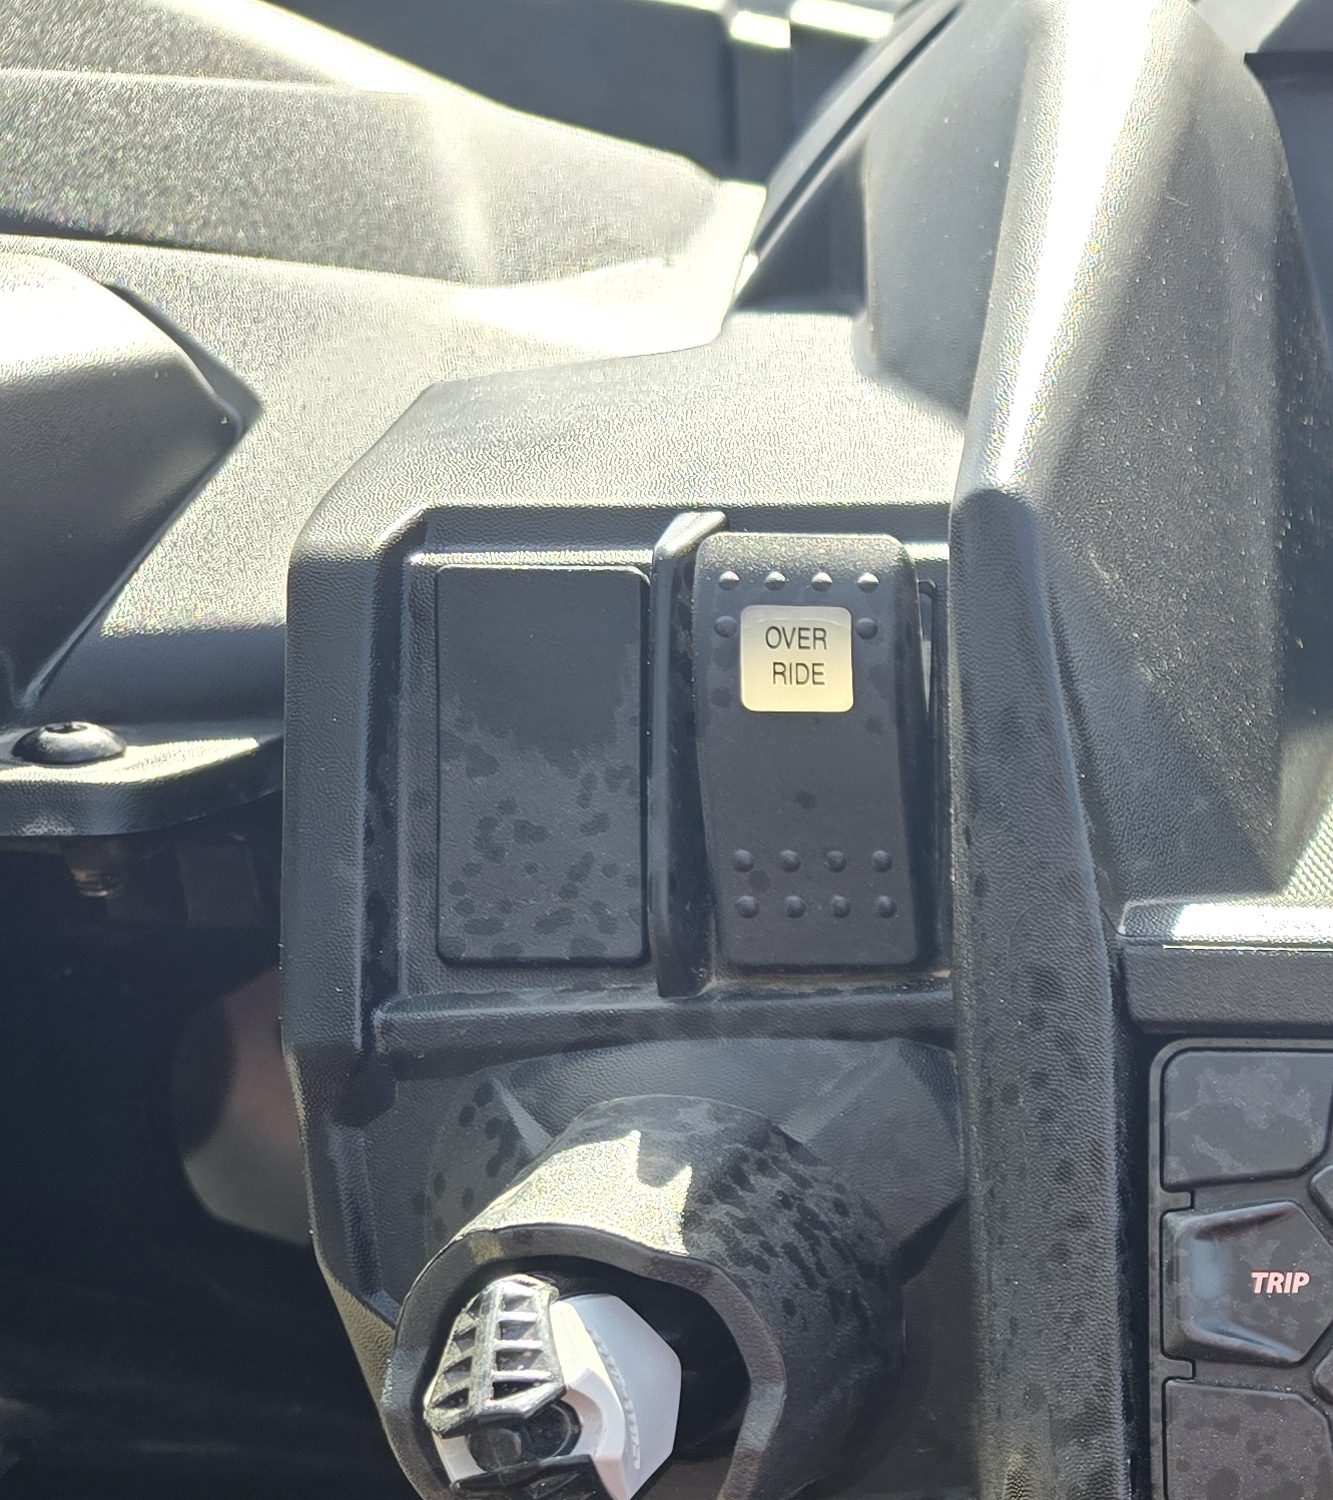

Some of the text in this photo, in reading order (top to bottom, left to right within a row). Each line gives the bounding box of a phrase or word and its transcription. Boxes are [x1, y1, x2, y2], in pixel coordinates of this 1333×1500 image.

[765, 625, 827, 650] OVER
[772, 661, 825, 686] RIDE
[1251, 1271, 1310, 1294] TRIP
